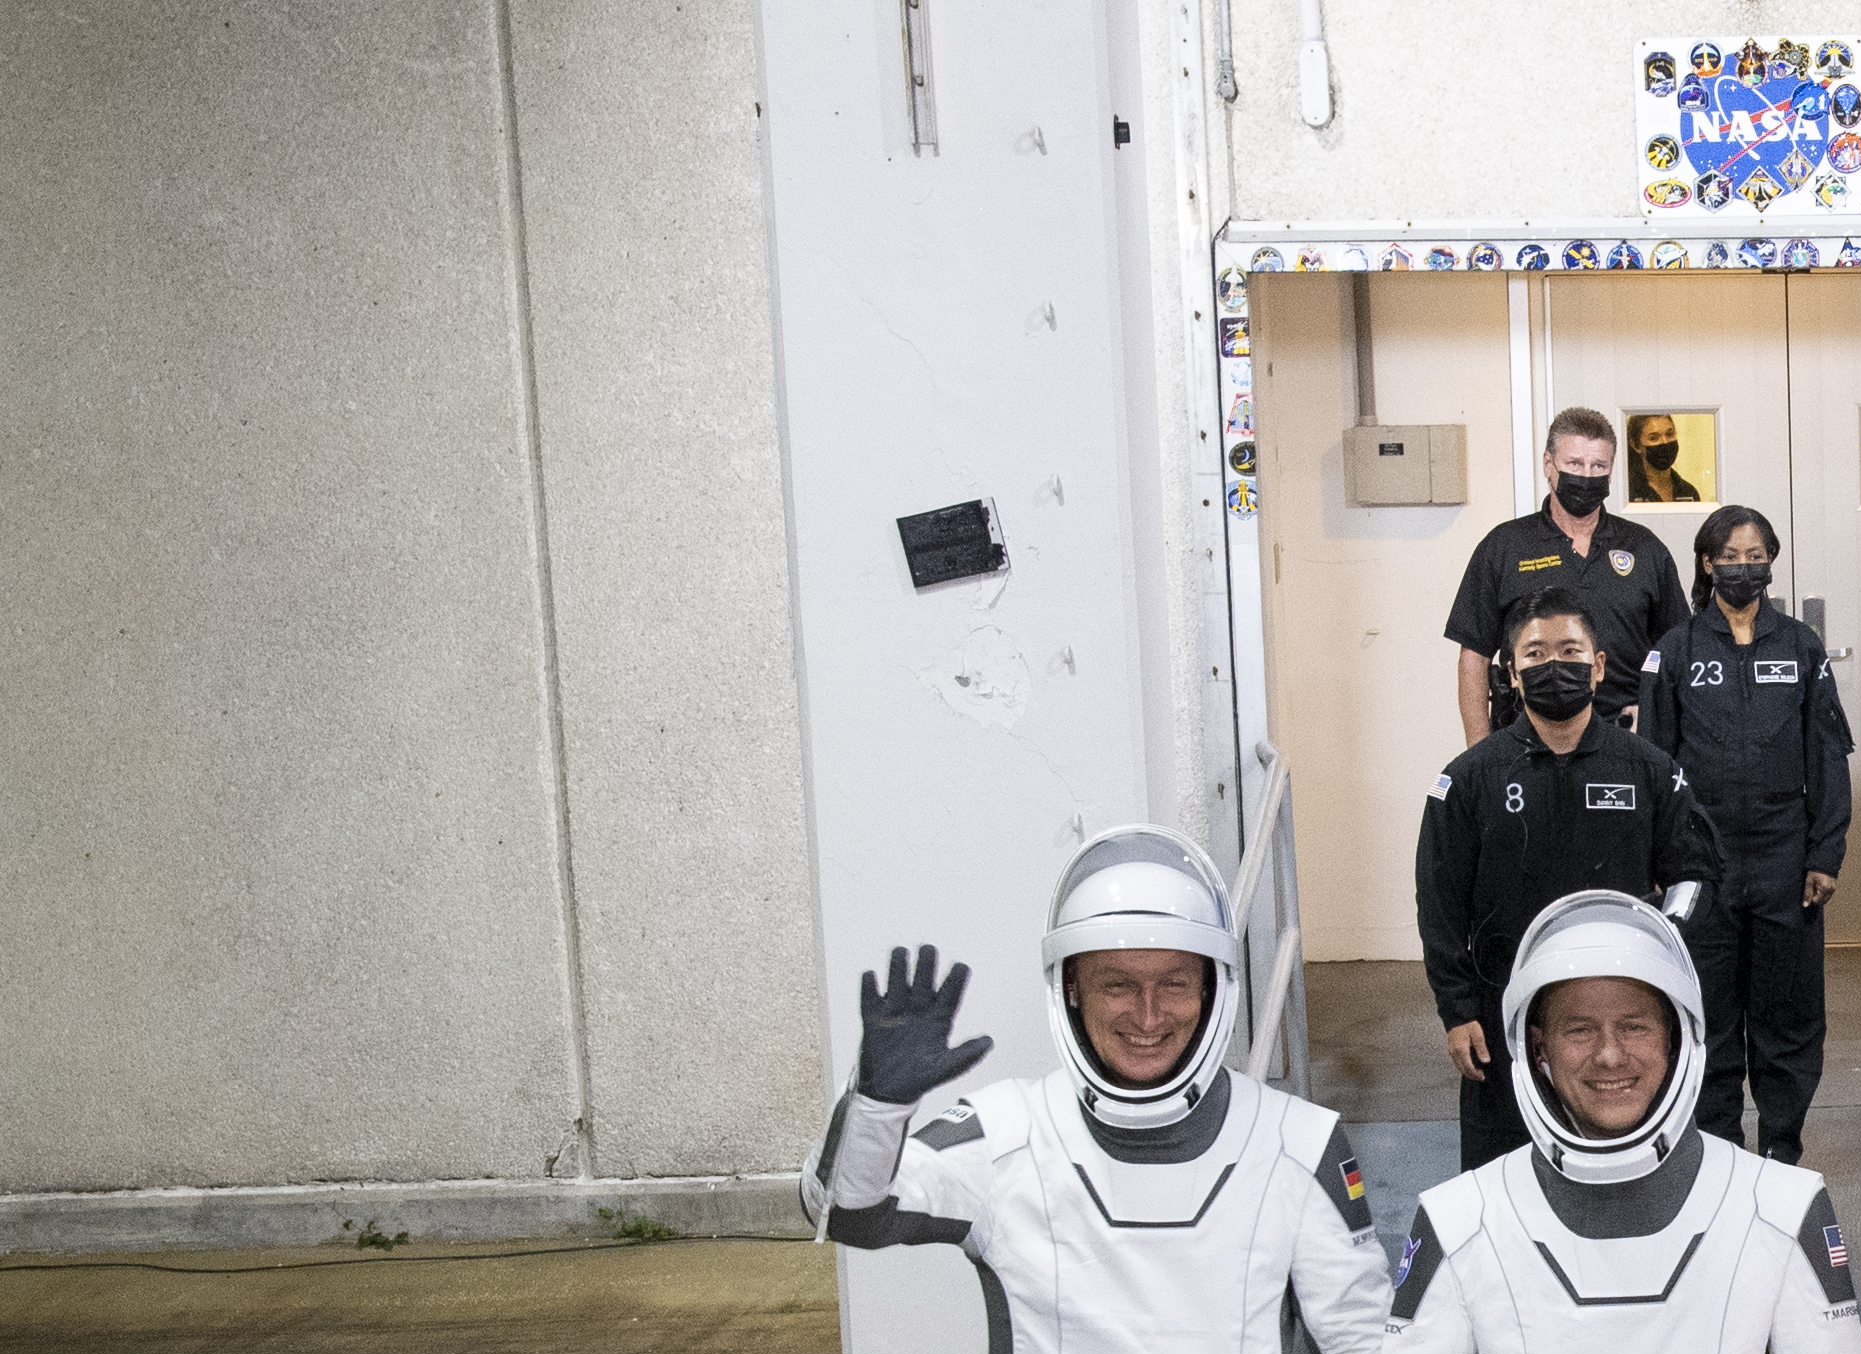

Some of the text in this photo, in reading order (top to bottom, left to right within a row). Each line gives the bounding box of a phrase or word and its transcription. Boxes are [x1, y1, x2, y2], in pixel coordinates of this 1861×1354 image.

[1690, 110, 1823, 143] NASA
[1690, 660, 1724, 687] 23
[1505, 782, 1525, 813] 8
